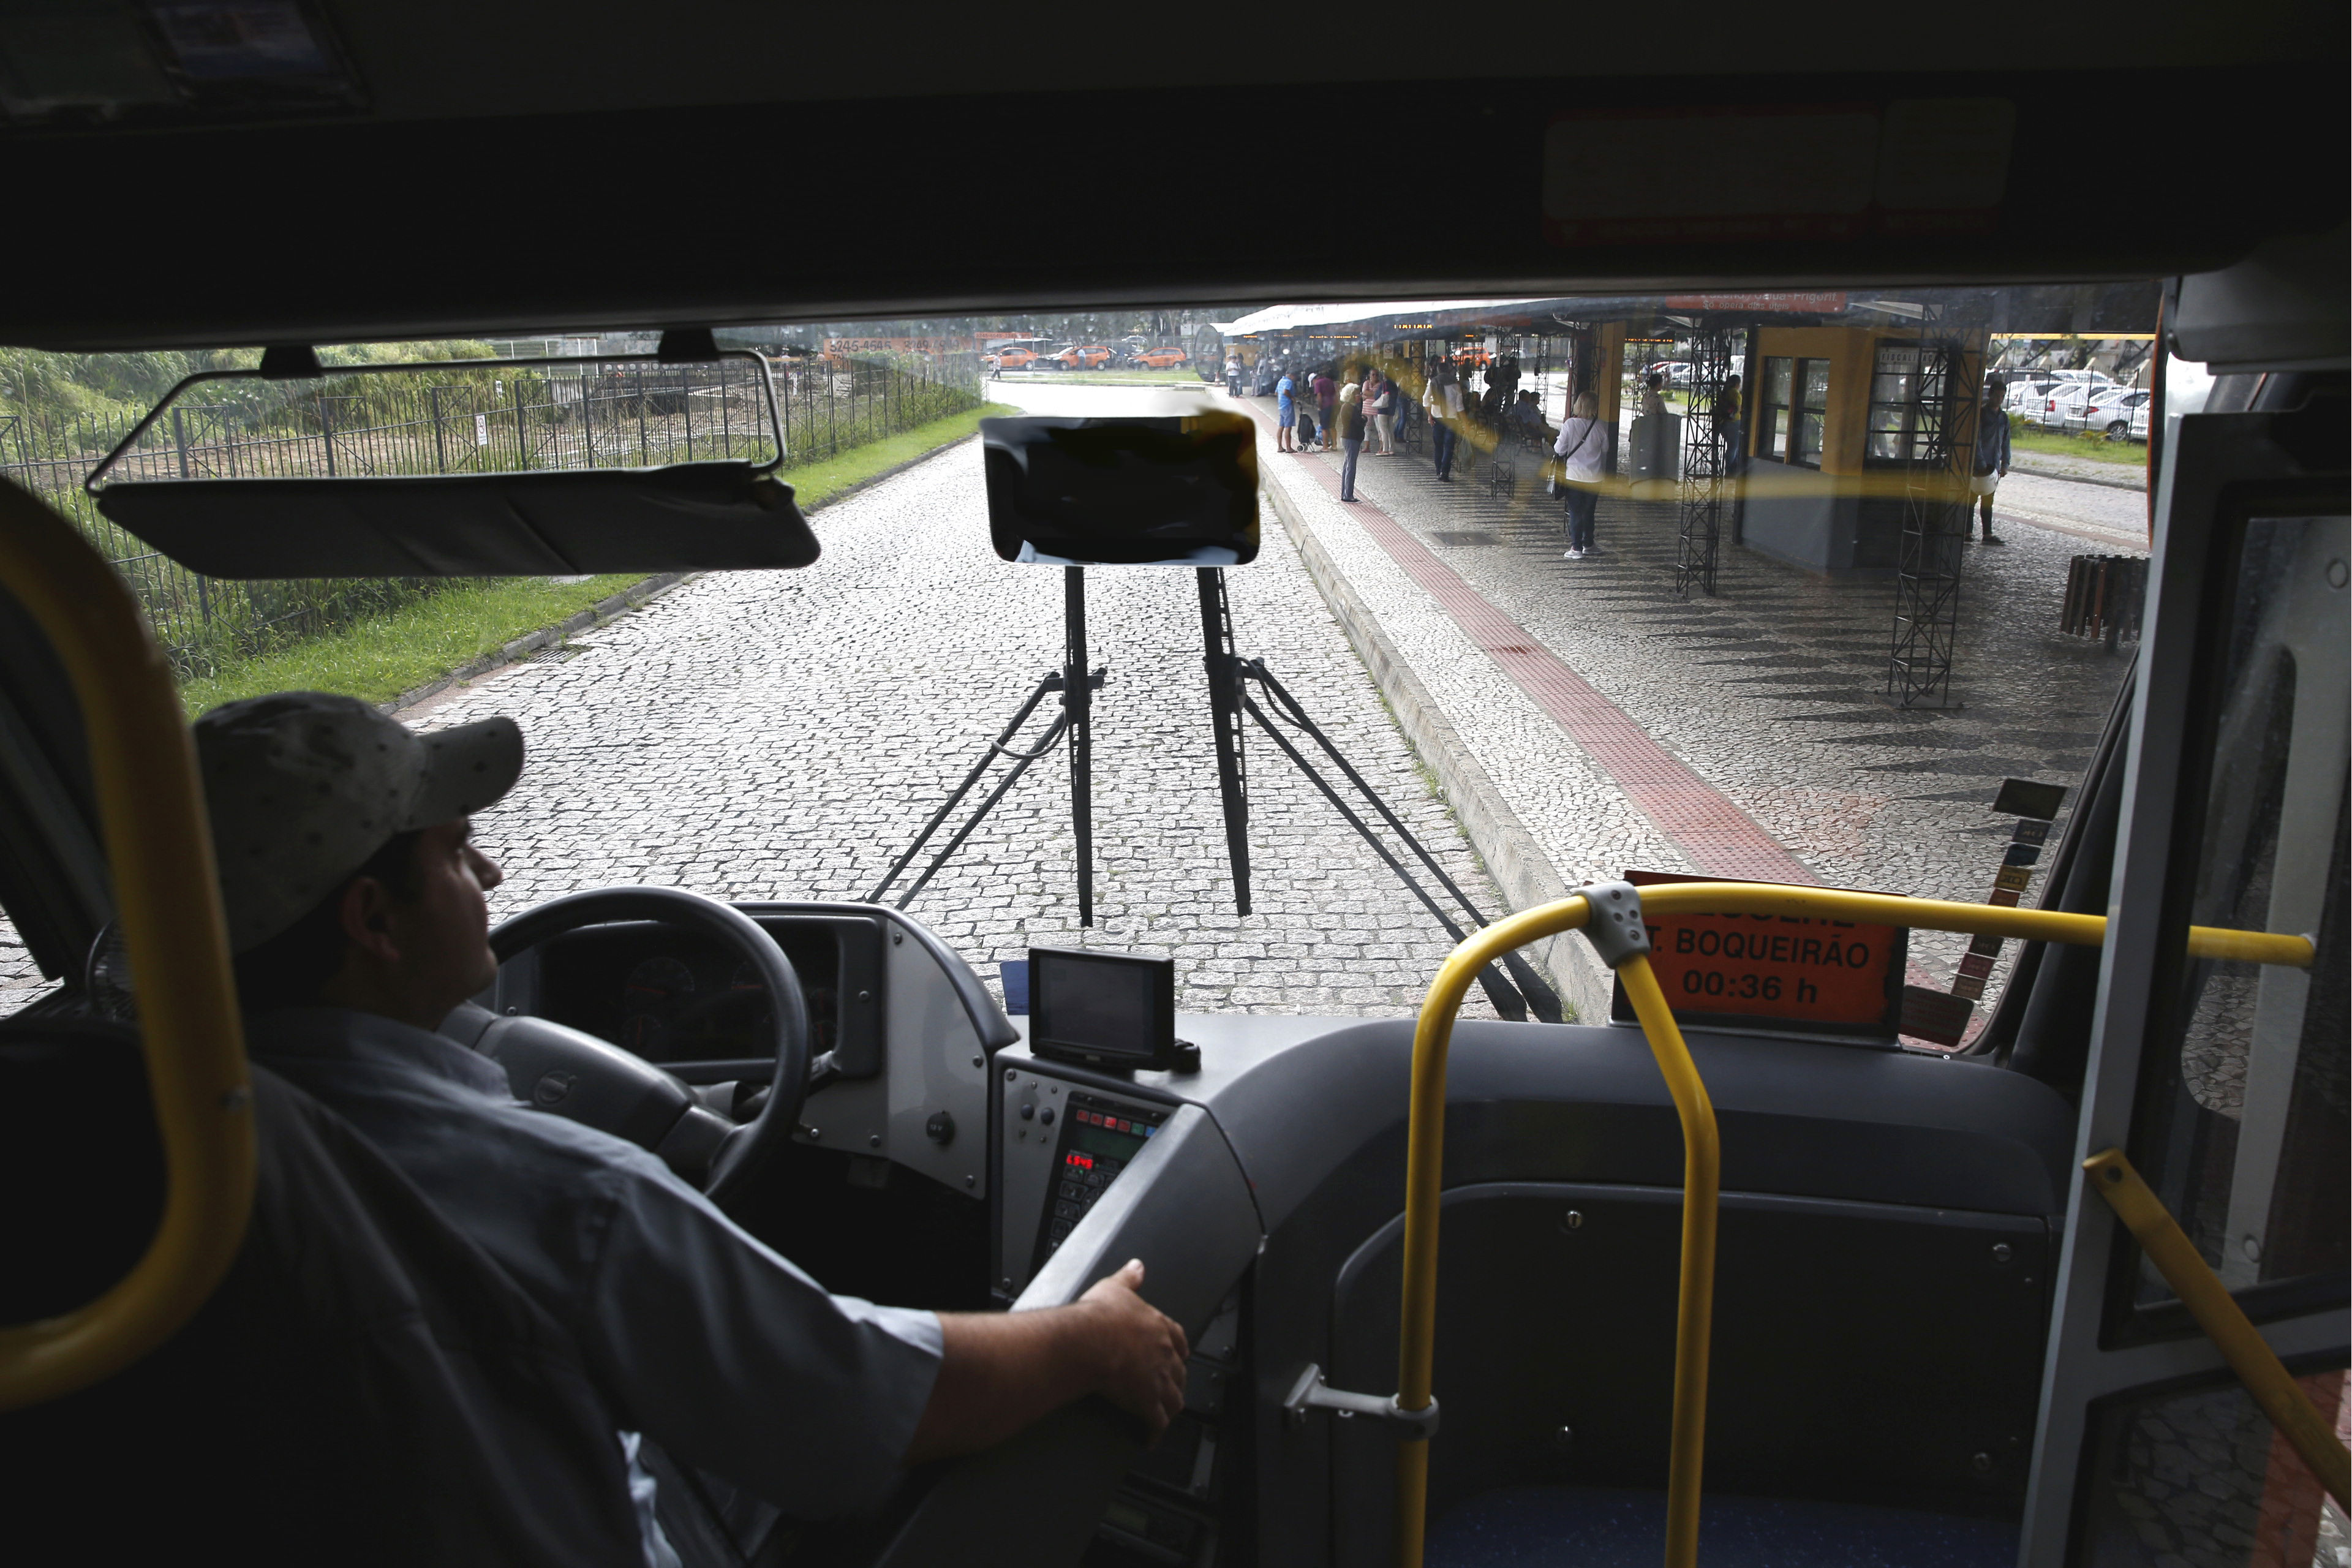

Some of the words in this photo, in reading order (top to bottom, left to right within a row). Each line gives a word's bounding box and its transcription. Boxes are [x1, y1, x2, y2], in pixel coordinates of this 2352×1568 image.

[1675, 927, 1870, 969] BOQUEIRÃO
[1683, 970, 1782, 1001] 00:36
[1796, 978, 1818, 1003] h
